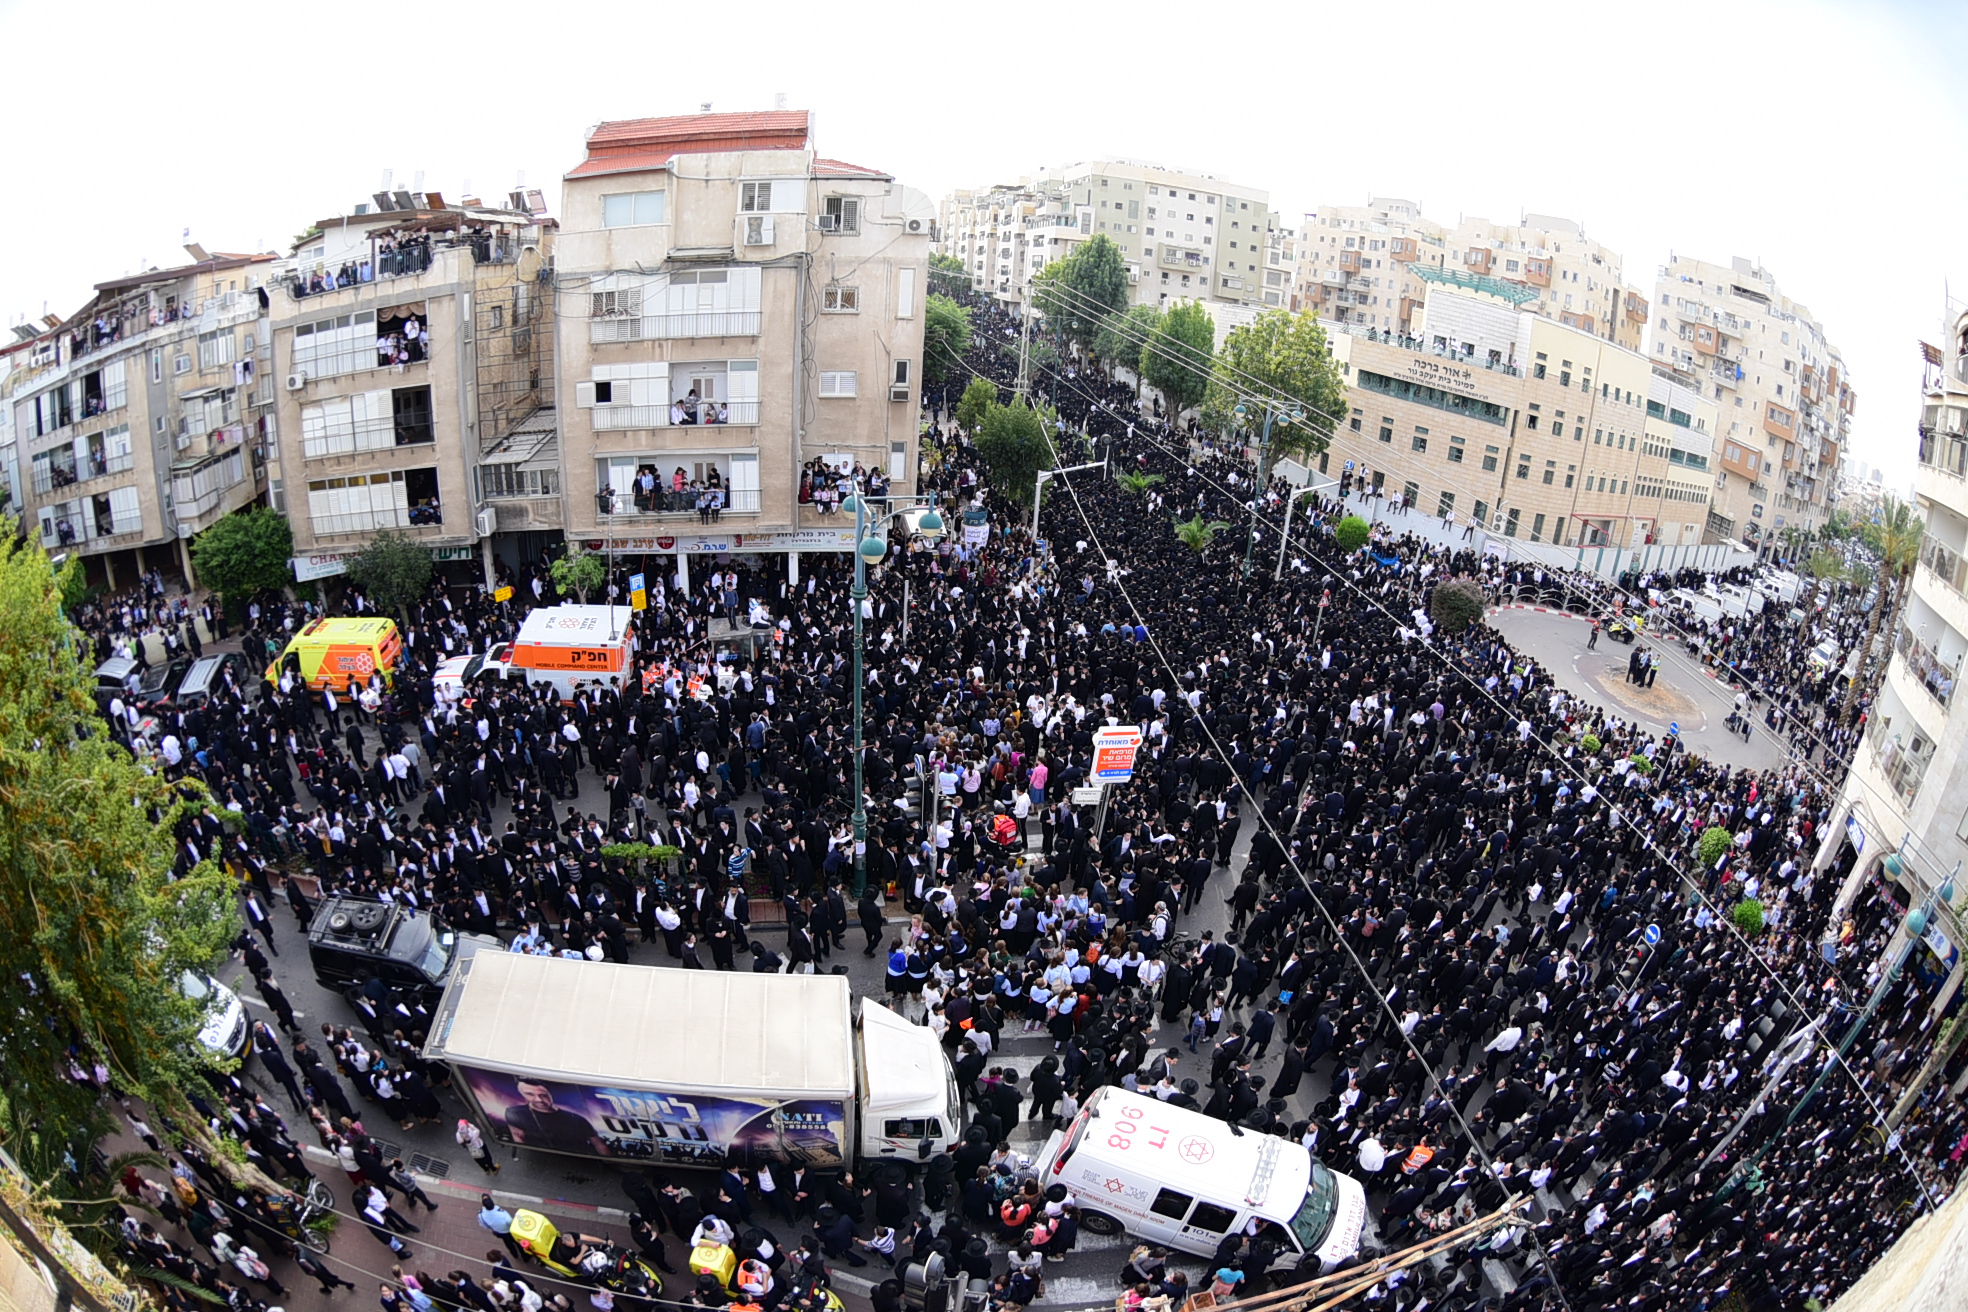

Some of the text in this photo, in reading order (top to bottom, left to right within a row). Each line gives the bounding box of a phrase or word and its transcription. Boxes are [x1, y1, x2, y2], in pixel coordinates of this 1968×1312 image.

[1414, 359, 1460, 378] אור ברכה
[1419, 370, 1437, 380] יעקב
[1438, 375, 1452, 384] בית
[1453, 378, 1475, 390] סמינר
[310, 552, 362, 566] CHANG
[571, 650, 608, 664] חפ"ק
[594, 1093, 701, 1122] ליאור
[600, 1115, 710, 1142] נרקיס
[1082, 1192, 1104, 1204] FRIENDS
[1114, 1204, 1132, 1214] MAGEN
[1134, 1210, 1148, 1218] DAVID
[1149, 1216, 1166, 1225] ADOM
[1348, 1210, 1356, 1223] דוד
[1350, 1198, 1366, 1250] AMBULANCE
[1192, 1228, 1210, 1238] 101
[1342, 1226, 1352, 1246] אדום
